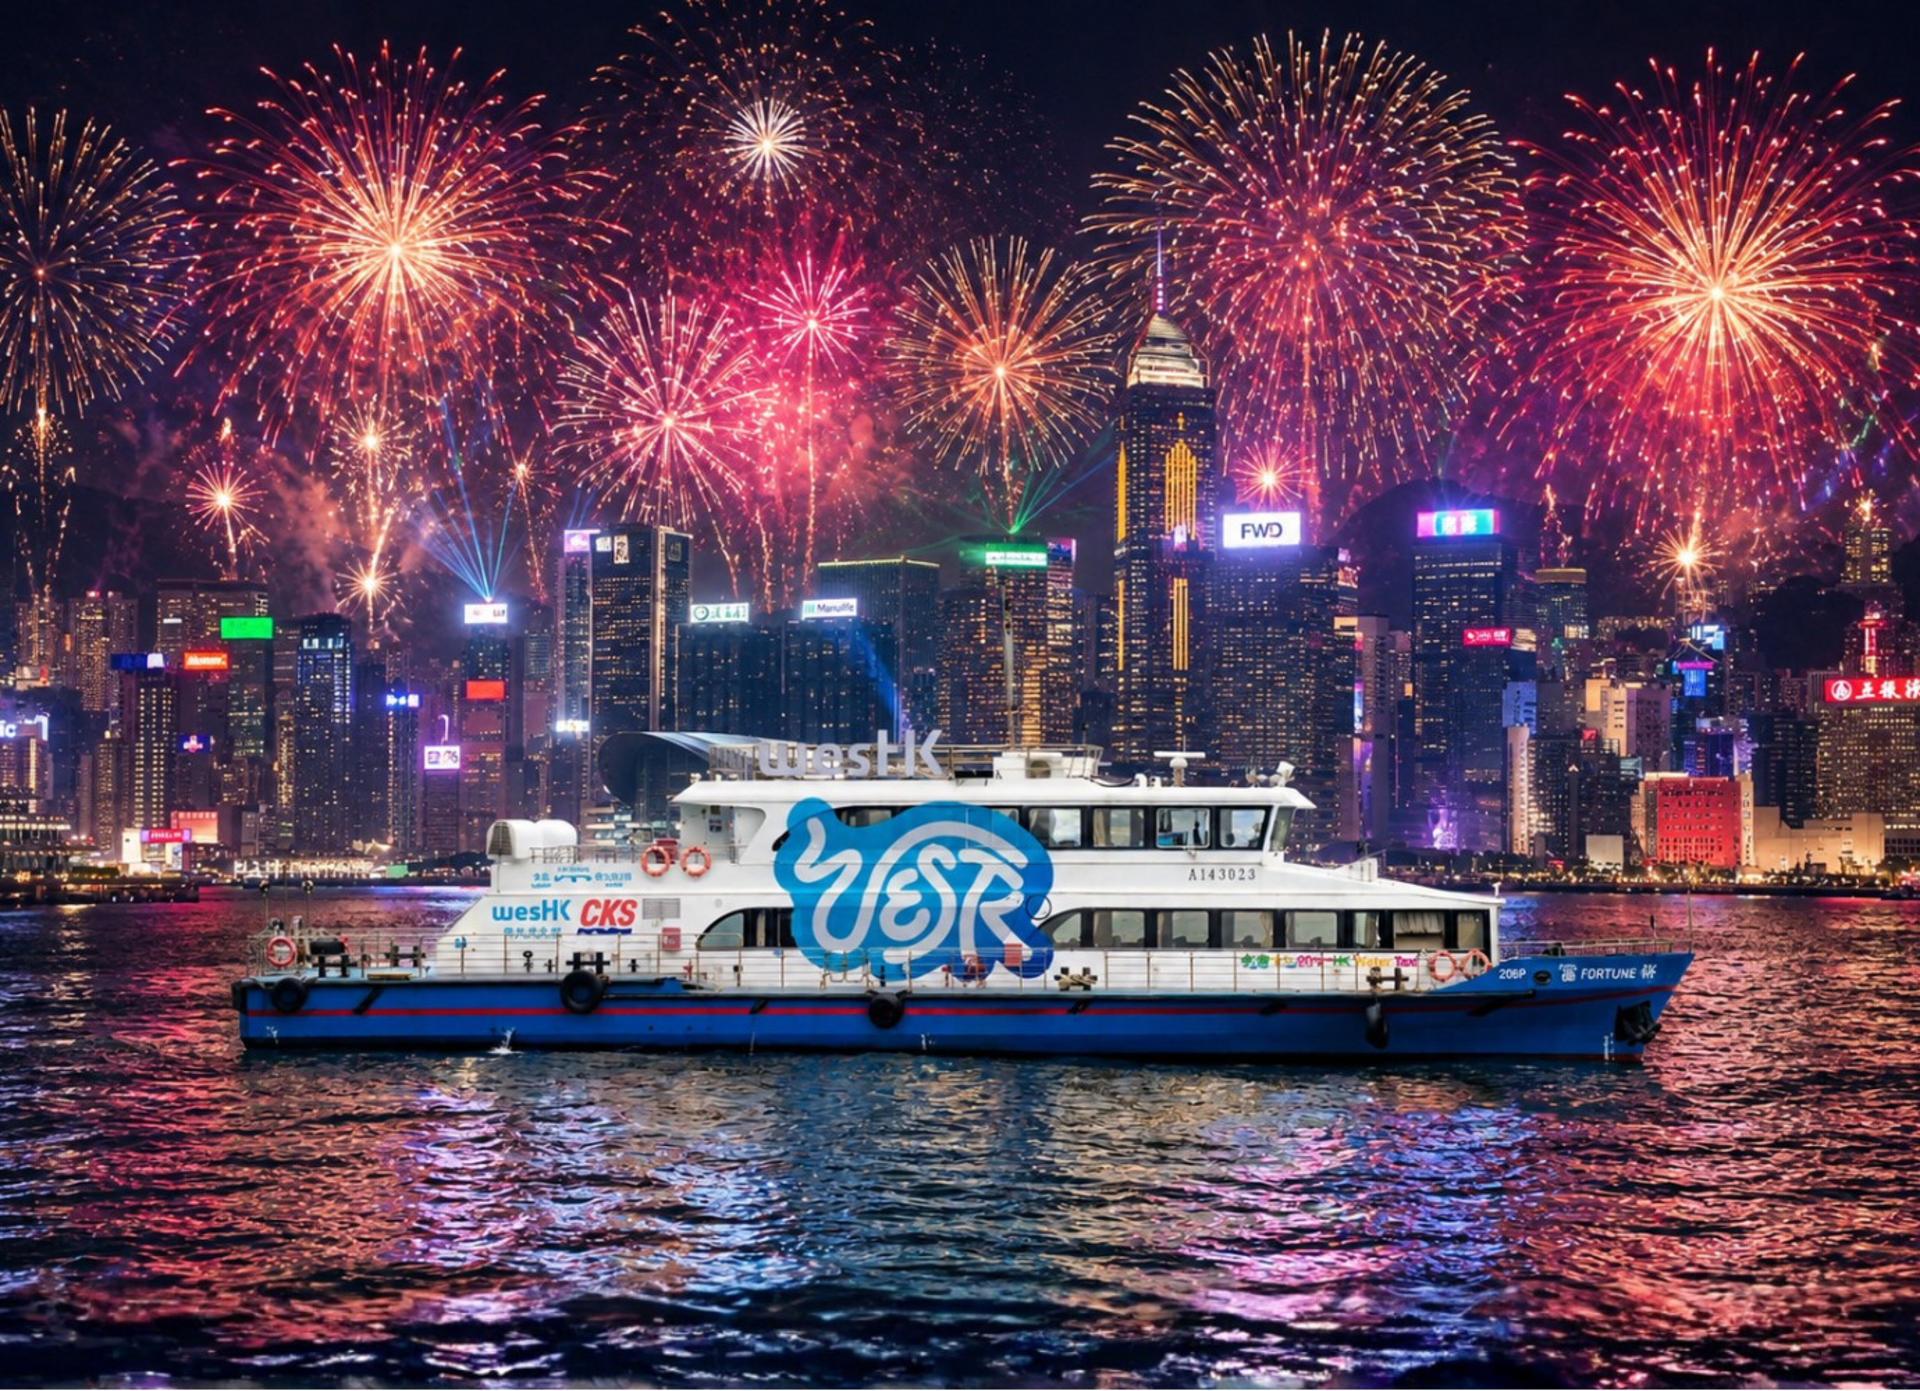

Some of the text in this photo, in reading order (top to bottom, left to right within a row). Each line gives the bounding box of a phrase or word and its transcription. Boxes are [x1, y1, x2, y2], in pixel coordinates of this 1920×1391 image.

[1241, 522, 1283, 539] FWD
[1188, 868, 1256, 881] A143023
[580, 898, 637, 927] CKS
[1581, 967, 1637, 980] FORTUNE
